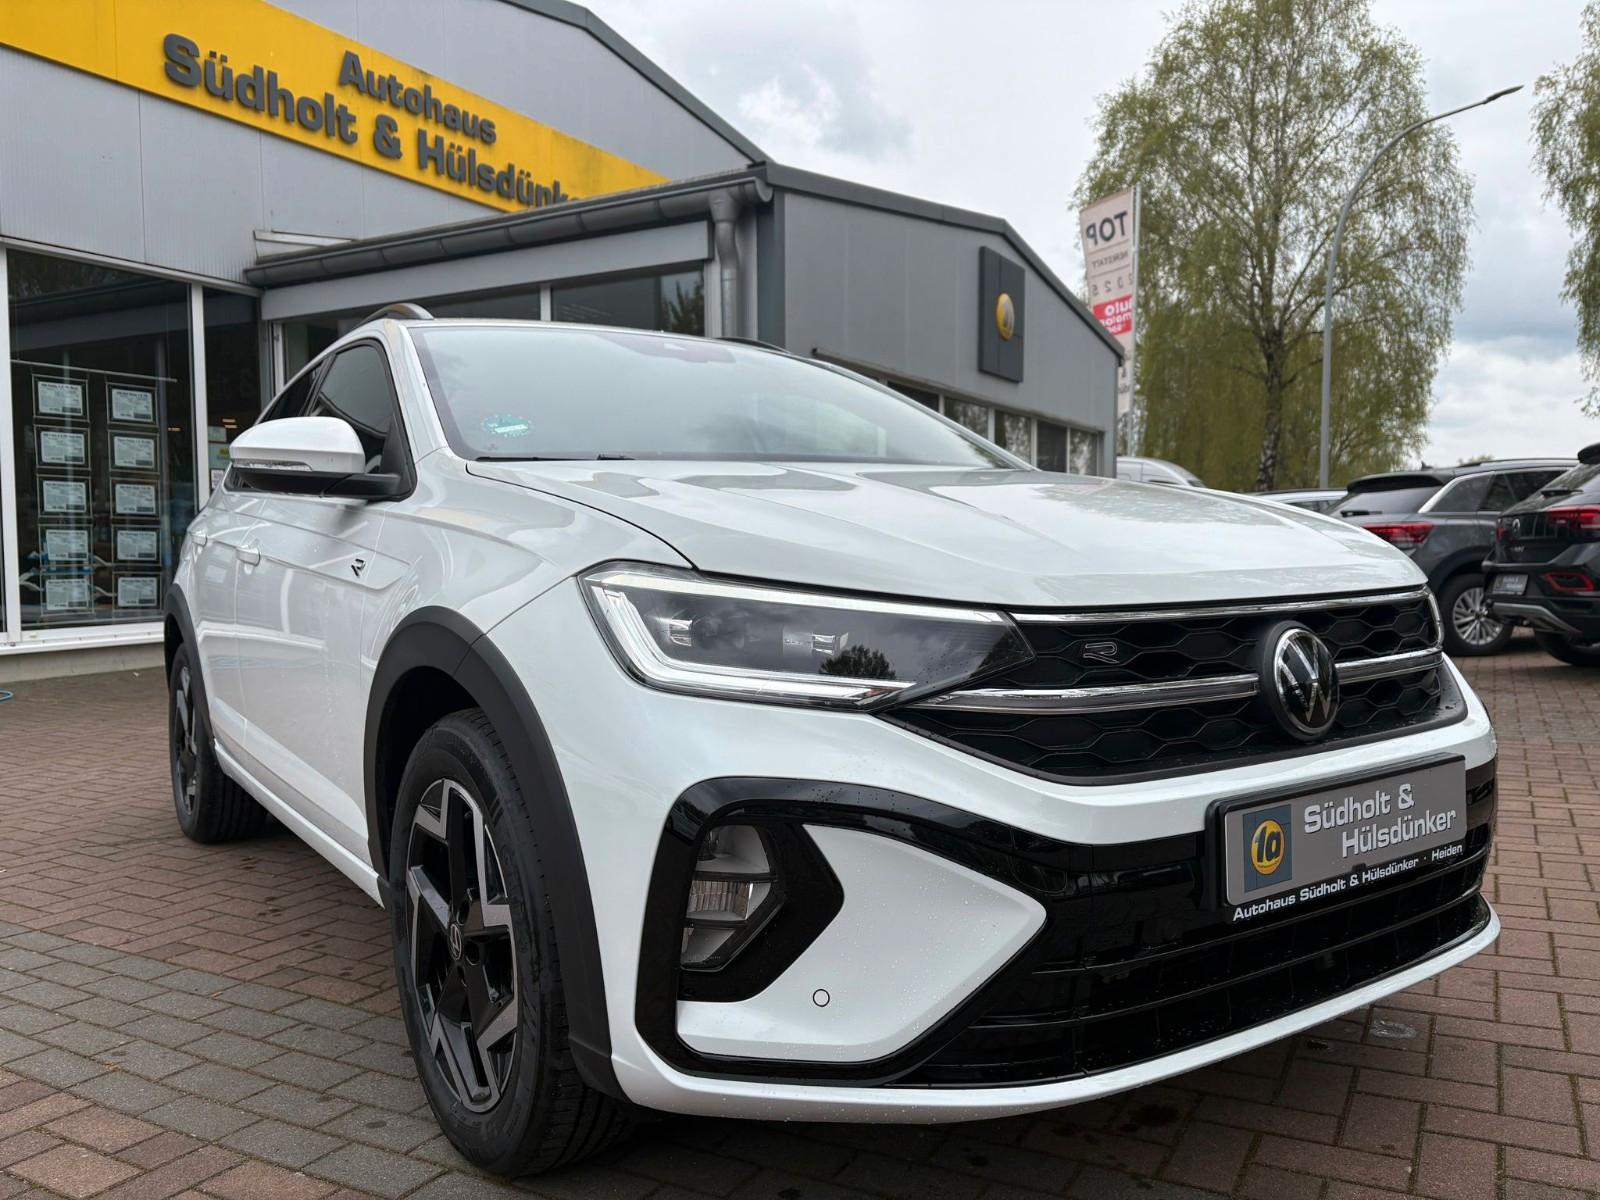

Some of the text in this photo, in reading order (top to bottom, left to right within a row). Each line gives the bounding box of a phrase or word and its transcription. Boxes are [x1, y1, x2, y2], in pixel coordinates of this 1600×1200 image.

[163, 33, 580, 208] Südholt & Hülsdünk
[338, 50, 498, 145] Autohaus
[1303, 783, 1415, 834] Südholt &
[1341, 808, 1457, 858] Hülsdünker
[1232, 843, 1464, 922] Autohaus Südholt & Hülsdünker Heiden
